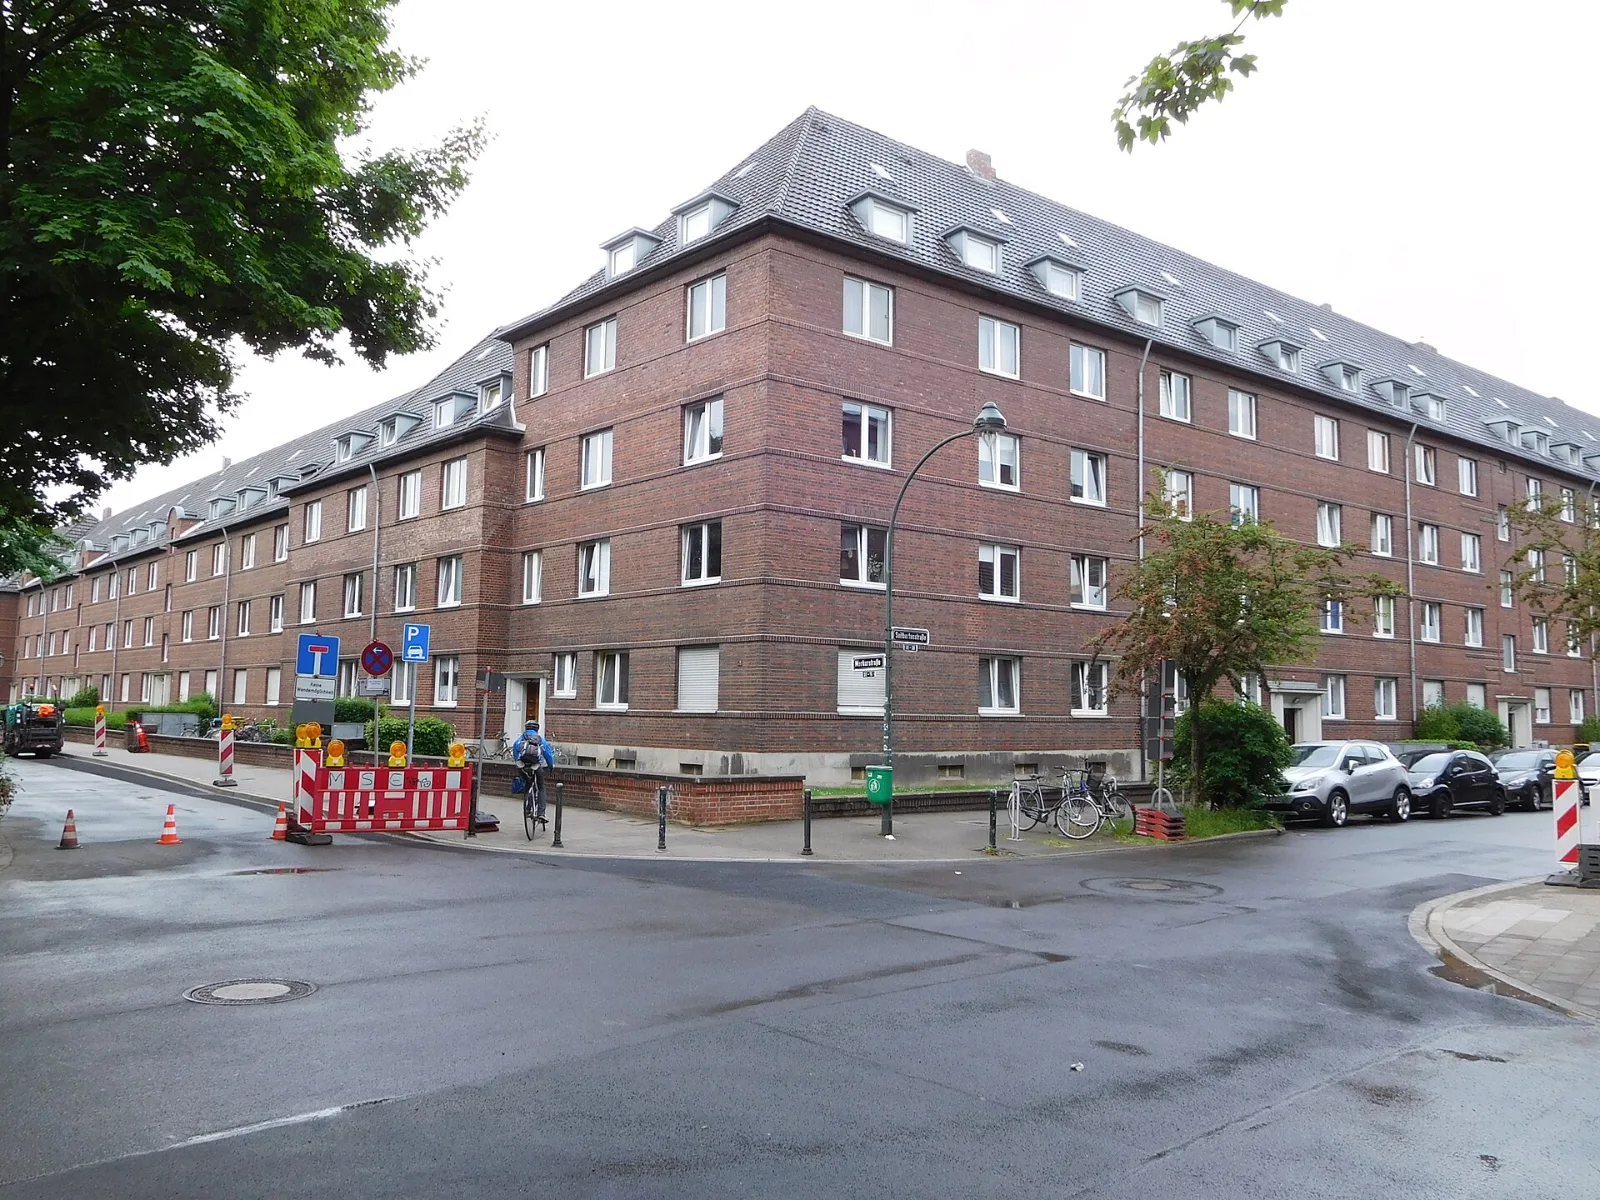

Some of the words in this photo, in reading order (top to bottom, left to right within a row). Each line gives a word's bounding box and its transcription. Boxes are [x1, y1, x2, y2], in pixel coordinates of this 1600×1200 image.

[407, 626, 419, 641] P
[854, 659, 881, 667] Merkurstraße
[297, 687, 334, 695] Wendemöglichkeit
